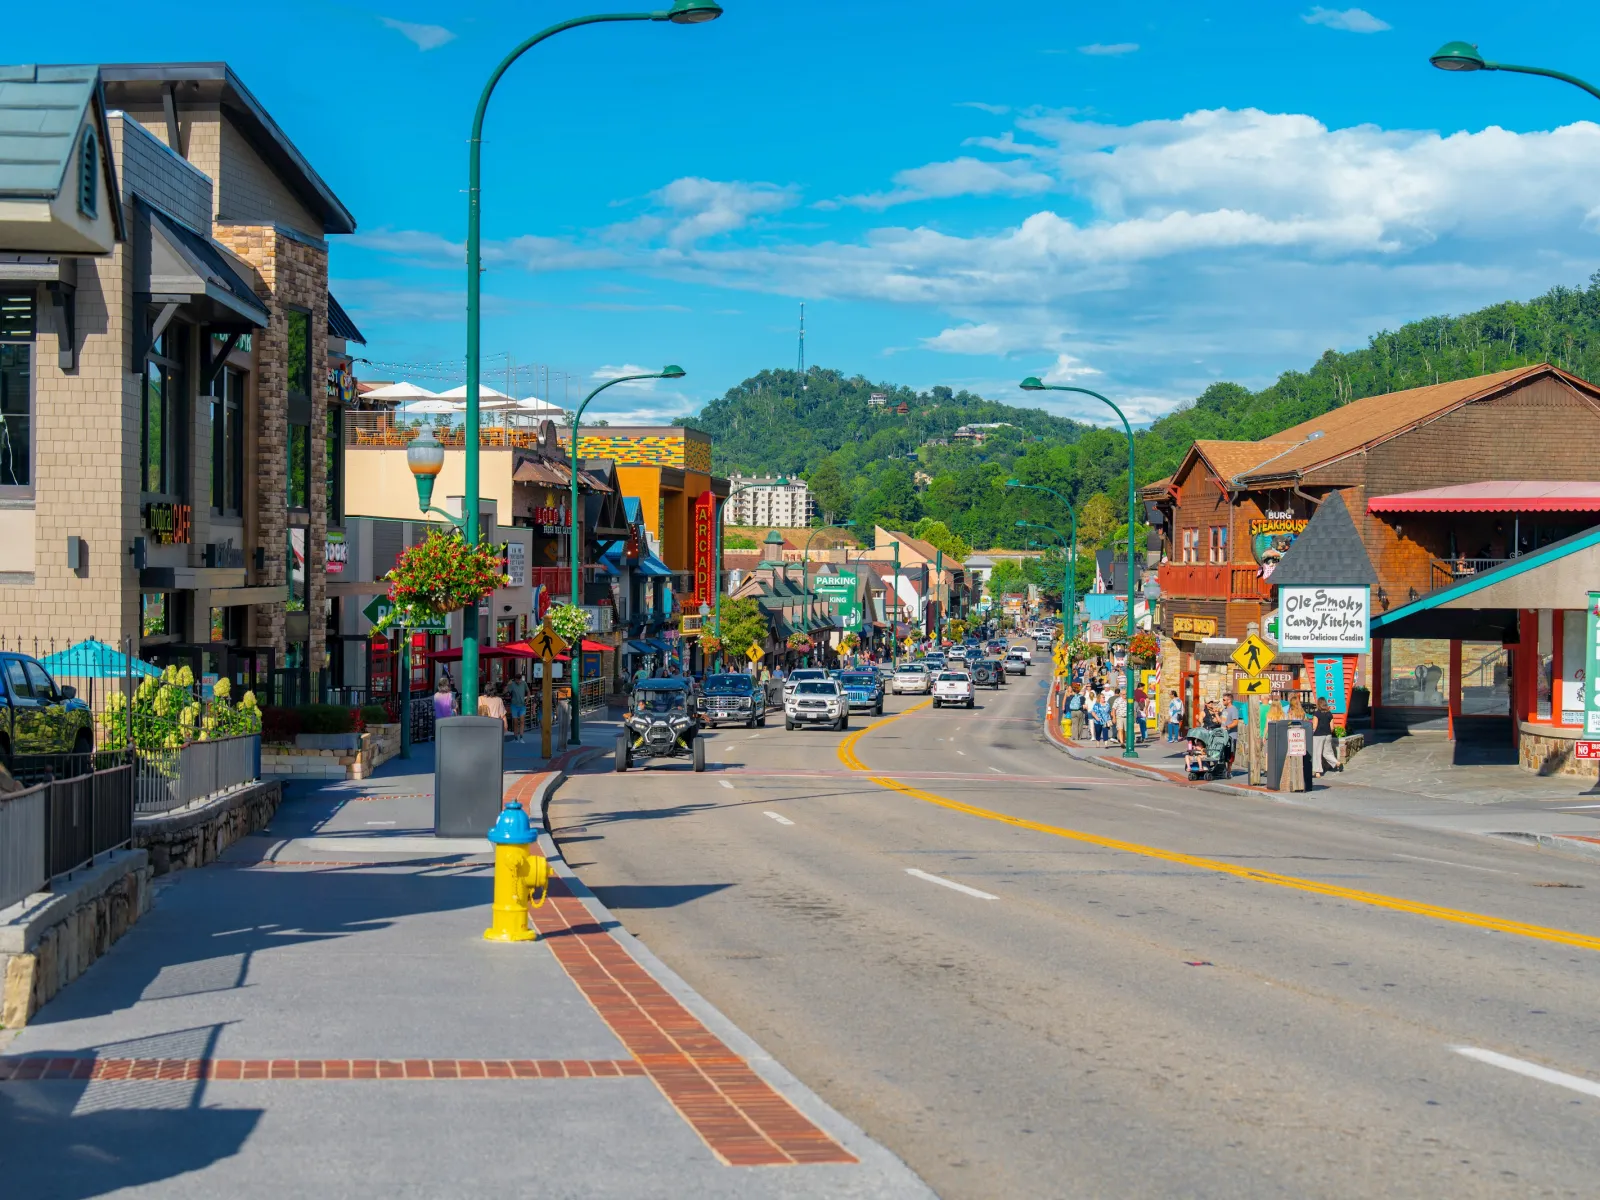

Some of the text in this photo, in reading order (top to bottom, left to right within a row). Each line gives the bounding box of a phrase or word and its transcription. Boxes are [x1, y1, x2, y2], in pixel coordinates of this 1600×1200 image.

[1268, 511, 1292, 520] BURG
[698, 508, 707, 600] ARCADE
[816, 576, 856, 584] PARKING
[1286, 590, 1362, 617] Ole Smoky
[1286, 614, 1318, 633] Candy
[1318, 612, 1362, 634] Kitchen
[1310, 633, 1338, 641] Delicious
[1340, 634, 1364, 642] Candies
[1325, 666, 1336, 710] PARKING
[1578, 746, 1588, 754] NO
